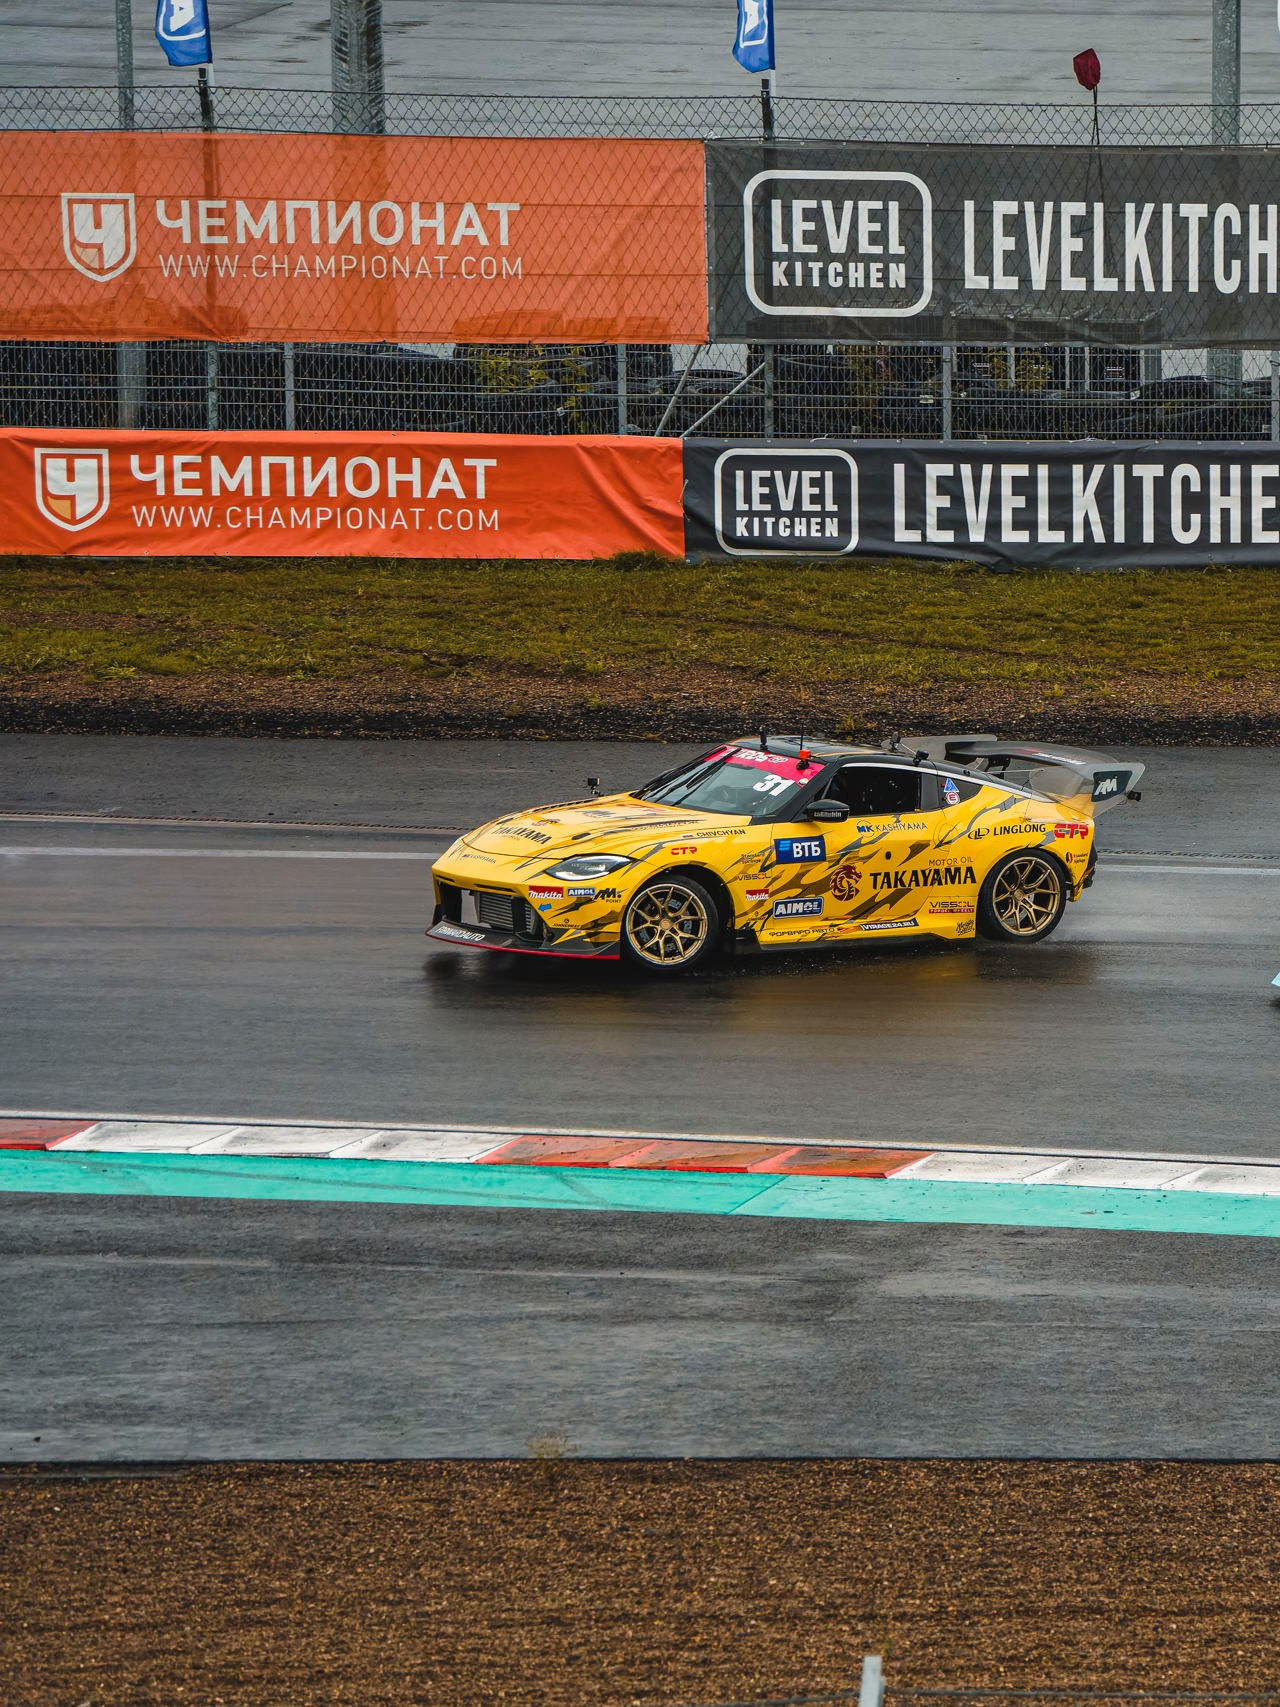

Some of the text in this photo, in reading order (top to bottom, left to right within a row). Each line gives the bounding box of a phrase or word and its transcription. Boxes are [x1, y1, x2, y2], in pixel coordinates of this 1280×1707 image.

[156, 199, 521, 247] ЧЕМПИОНАТ
[771, 199, 906, 255] LEVEL
[159, 254, 523, 280] WWW.CHAMPIONAT.COM
[772, 261, 906, 289] KITCHEN
[130, 455, 497, 500] ЧЕМПИОНАТ
[735, 470, 839, 512] LEVEL
[131, 505, 500, 531] WWW.CHAMPIONAT.COM
[735, 517, 839, 538] KITCHEN
[752, 774, 796, 797] 31
[697, 829, 747, 837] CHIVCHYAN
[876, 821, 929, 832] KASHIYAMA
[993, 823, 1047, 836] LINGLONG
[1053, 823, 1089, 840] CTR
[671, 846, 698, 856] CTR
[793, 841, 821, 858] ВТБ
[928, 857, 958, 867] MOTOR
[869, 866, 977, 890] TAKAYAMA
[568, 888, 595, 896] AIMOL
[775, 901, 821, 916] AIMOL
